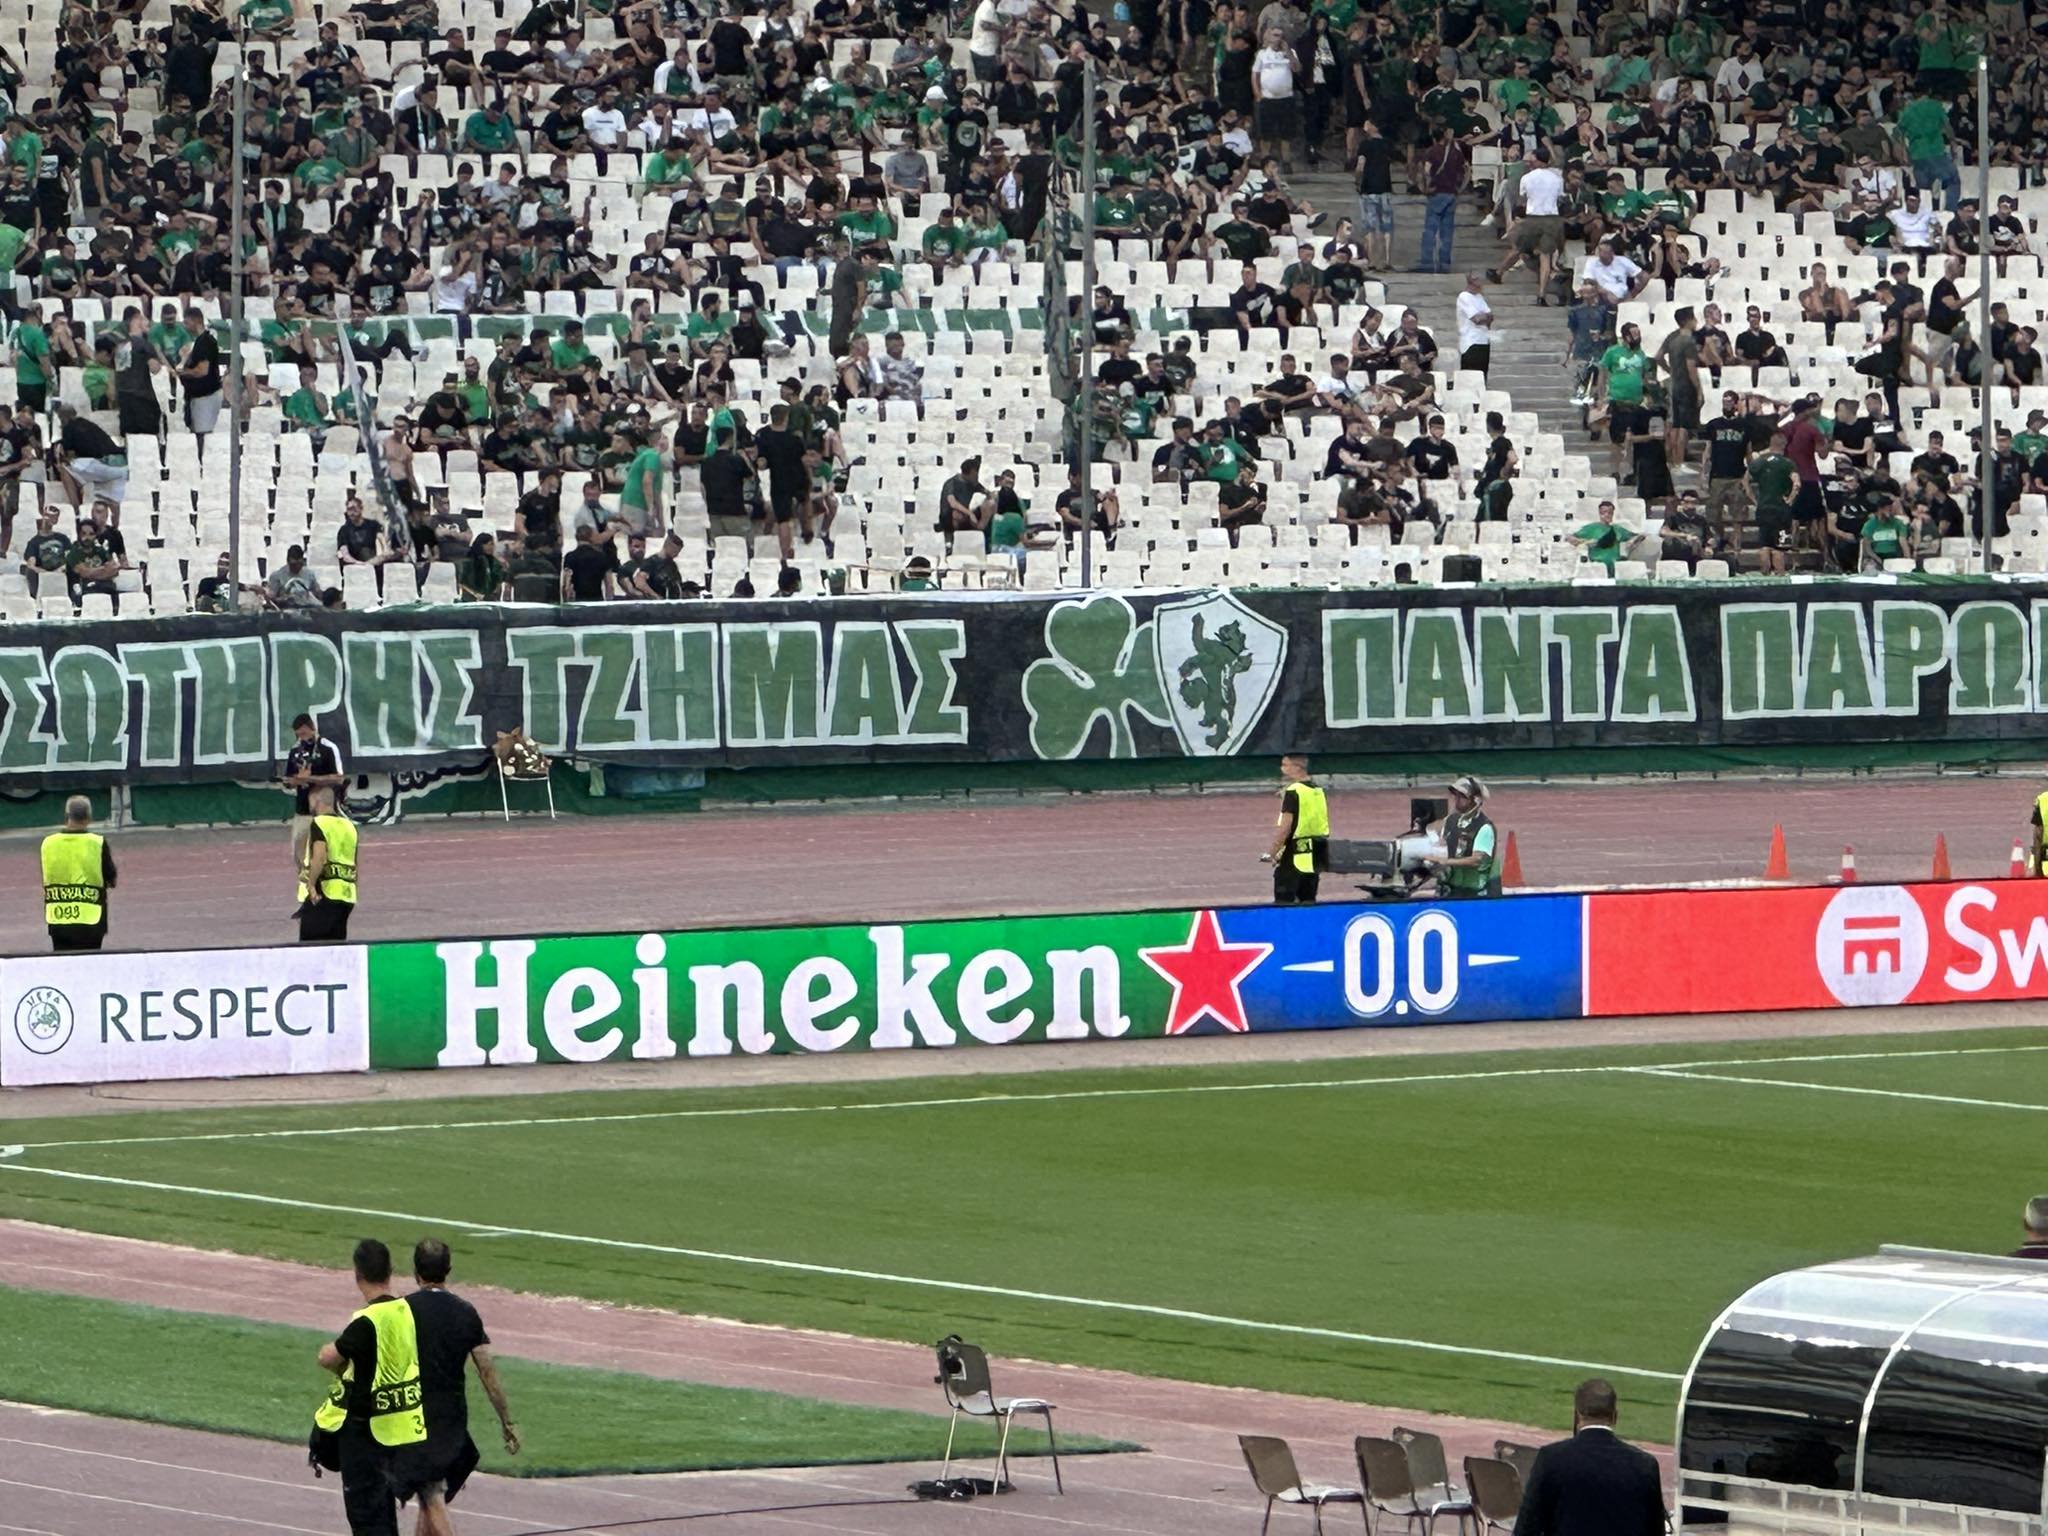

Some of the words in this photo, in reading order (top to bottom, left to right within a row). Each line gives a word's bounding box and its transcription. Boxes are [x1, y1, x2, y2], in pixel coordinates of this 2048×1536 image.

[0, 629, 483, 774] ΣΩΤΗΡΗΣ
[506, 618, 968, 756] ΤΖΗΜΑΣ
[1322, 604, 1697, 728] ΠΑΝΤΑ
[1720, 598, 2048, 719] ΠΑΡΩ
[101, 983, 348, 1043] RESPECT
[436, 926, 1130, 1066] Heineken
[1344, 909, 1459, 1017] 0.0
